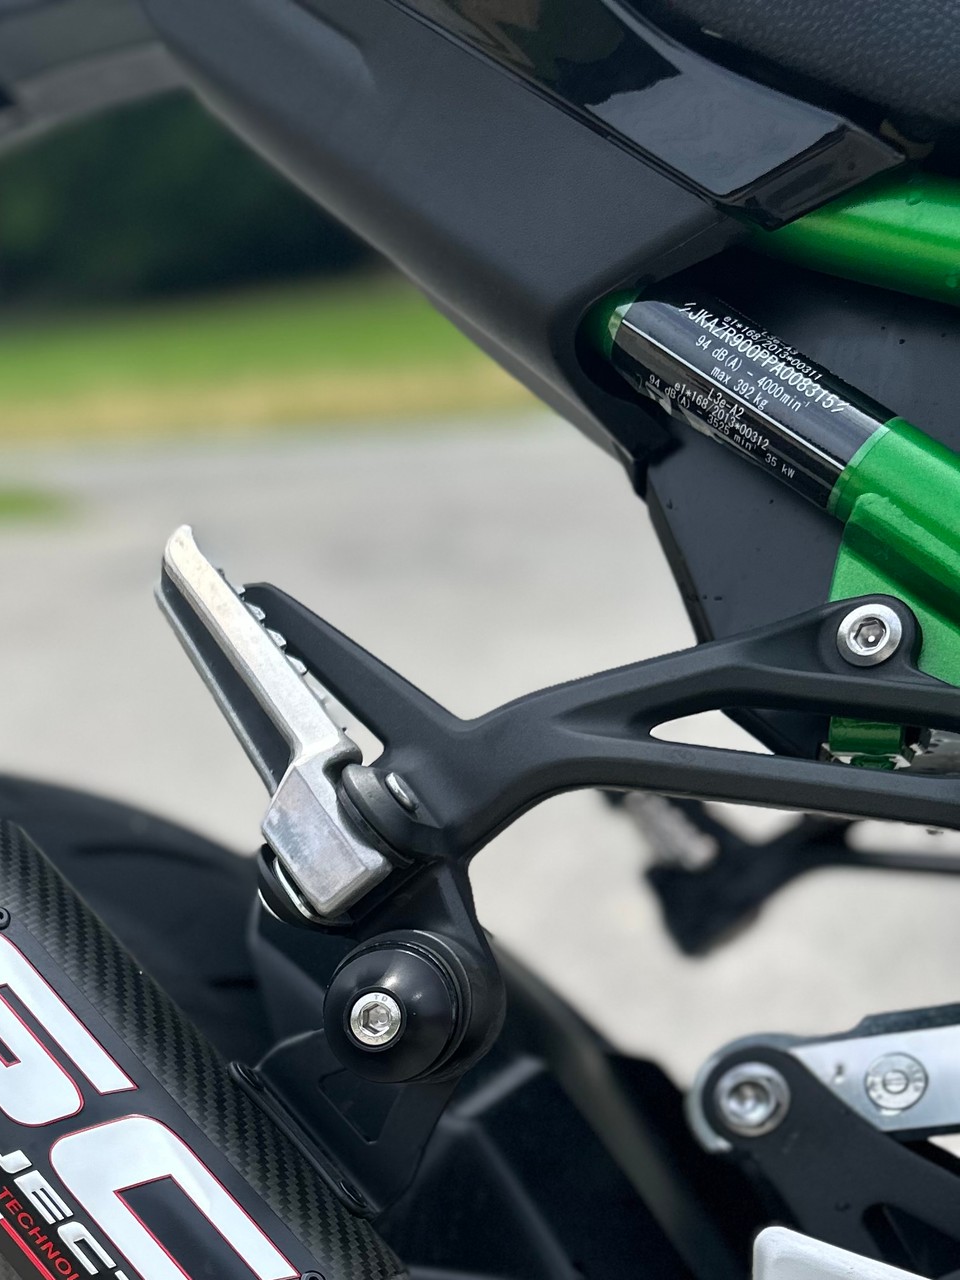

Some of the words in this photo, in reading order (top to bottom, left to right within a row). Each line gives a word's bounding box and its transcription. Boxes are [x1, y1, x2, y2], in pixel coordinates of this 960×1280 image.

[695, 335, 711, 353] 94
[712, 347, 742, 372] dB(A)
[707, 388, 745, 420] L3e-A2
[710, 366, 730, 386] max
[733, 378, 754, 398] 392
[754, 392, 769, 411] kg
[649, 374, 662, 389] 94
[707, 414, 730, 436] 3525
[764, 453, 778, 467] 35
[781, 463, 795, 478] kW
